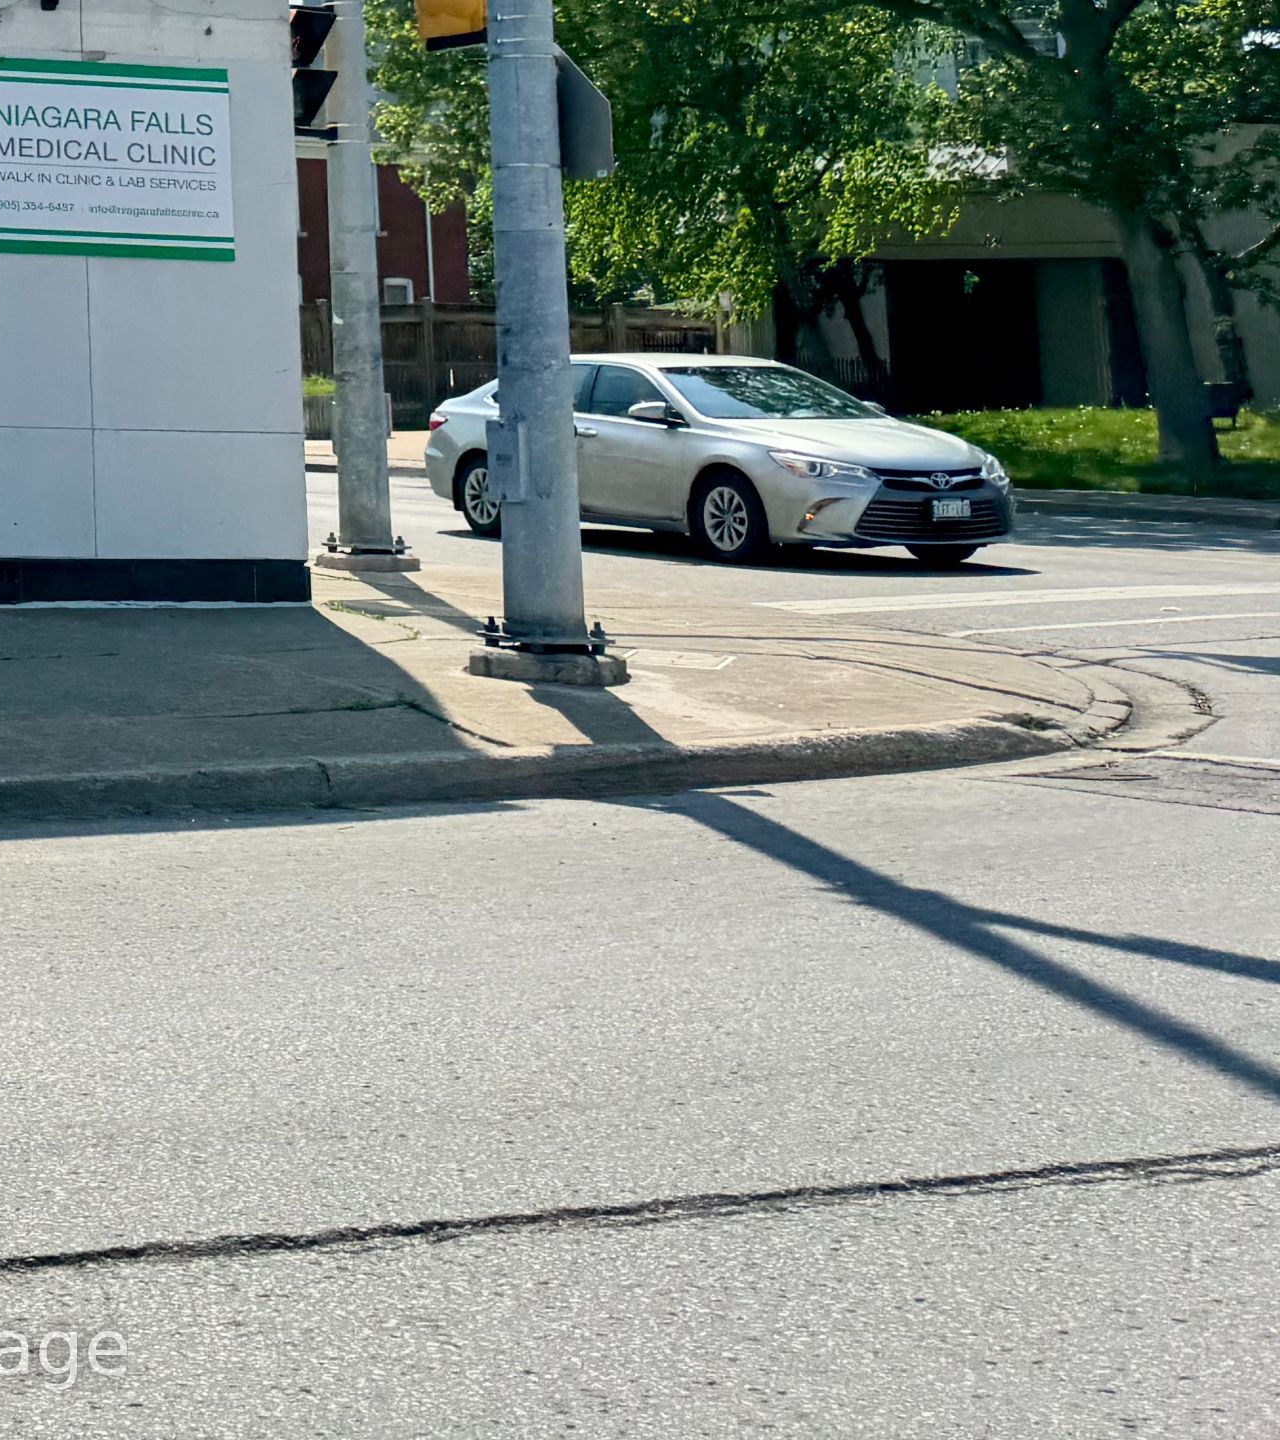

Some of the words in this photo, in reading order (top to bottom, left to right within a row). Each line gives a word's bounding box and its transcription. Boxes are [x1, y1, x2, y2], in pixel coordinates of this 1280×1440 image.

[131, 110, 214, 136] FALLS
[127, 142, 217, 167] CLINIC
[37, 173, 52, 184] IN
[55, 174, 102, 187] CLINIC
[105, 176, 116, 187] &
[118, 177, 146, 189] LAB
[149, 178, 217, 192] SERVICES
